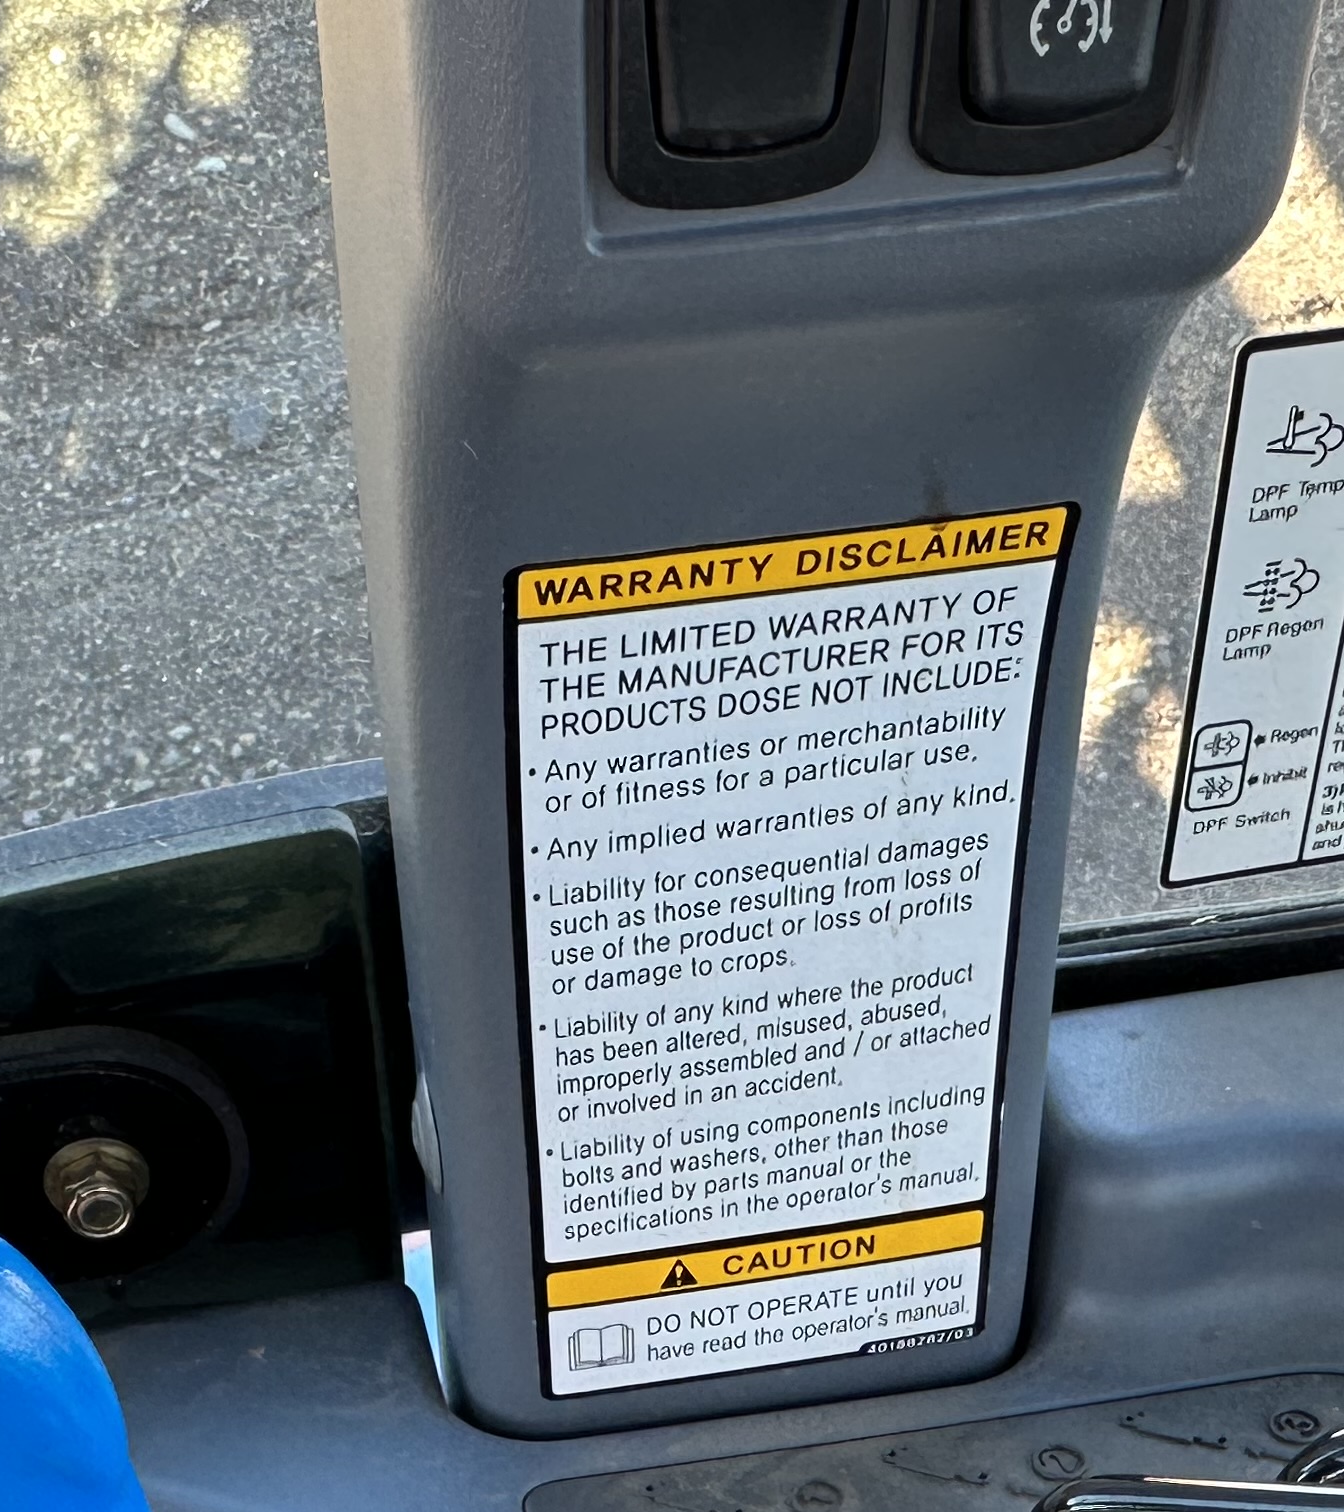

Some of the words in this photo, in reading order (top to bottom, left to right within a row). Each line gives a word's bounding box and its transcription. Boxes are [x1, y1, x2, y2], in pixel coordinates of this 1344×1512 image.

[534, 553, 774, 606] WARRANTY
[796, 521, 1050, 576] DISCLAIMER
[538, 636, 608, 668] THE
[620, 619, 756, 659] LIMITED
[768, 592, 963, 641] WARRANTY
[972, 585, 1019, 616] OF
[539, 672, 606, 704] THE
[618, 638, 890, 695] MANUFACTURER
[901, 628, 966, 661] FOR
[976, 620, 1024, 651] ITS
[541, 695, 706, 740] PRODUCTS
[718, 683, 801, 719] DOSE
[811, 675, 874, 708] NOT
[882, 656, 1024, 698] INCLUDE:
[544, 758, 598, 784] Any
[607, 737, 751, 775] warranties
[759, 735, 789, 756] or
[797, 705, 1007, 751] merchantability
[545, 794, 573, 814] or
[581, 784, 607, 810] of
[616, 777, 706, 806] fitness
[716, 768, 750, 793] for
[759, 769, 774, 788] a
[784, 748, 916, 790] particular
[923, 743, 978, 766] use.
[546, 837, 598, 862] Any
[608, 818, 705, 855] implied
[716, 803, 854, 840] warranties
[863, 794, 888, 821] of
[896, 793, 945, 817] any
[952, 778, 1015, 809] kind.
[549, 875, 646, 907] Liability
[654, 870, 687, 894] for
[694, 842, 870, 889] consequential
[877, 832, 989, 865] damages
[549, 908, 609, 937] such
[617, 908, 646, 929] as
[654, 899, 721, 924] those
[730, 884, 835, 914] resulting
[844, 875, 896, 899] from
[905, 867, 952, 891] loss
[959, 856, 983, 882] of
[551, 945, 594, 967] use
[602, 935, 624, 960] of
[633, 932, 671, 956] the
[679, 917, 774, 956] product
[781, 917, 807, 937] or
[814, 909, 861, 932] loss
[868, 898, 892, 925] of
[898, 891, 973, 925] profits
[551, 976, 577, 996] or
[584, 963, 683, 992] damage
[691, 956, 713, 977] to
[720, 948, 797, 974] crops.
[554, 1010, 639, 1039] Liability
[645, 1003, 666, 1028] of
[673, 1003, 715, 1025] any
[722, 990, 769, 1018] kind
[777, 986, 843, 1010] where
[850, 977, 884, 1000] the
[891, 962, 973, 999] product
[555, 1046, 595, 1068] has
[602, 1039, 658, 1062] been
[666, 1022, 748, 1054] altered,
[756, 1007, 853, 1041] misused,
[860, 993, 947, 1026] abused,
[556, 1061, 673, 1097] improperly
[679, 1041, 798, 1080] assembled
[804, 1035, 846, 1062] and
[852, 1030, 865, 1058] /
[870, 1033, 893, 1052] or
[899, 1013, 992, 1048] attached
[557, 1105, 580, 1123] or
[587, 1086, 676, 1120] involved
[685, 1084, 703, 1106] in
[710, 1084, 737, 1103] an
[745, 1065, 843, 1098] accident.
[560, 1133, 646, 1162] Liability
[652, 1126, 673, 1149] of
[680, 1121, 739, 1146] using
[747, 1100, 881, 1137] components
[888, 1085, 986, 1116] including
[562, 1165, 615, 1188] bolts
[621, 1155, 662, 1181] and
[670, 1146, 767, 1174] washers,
[774, 1135, 831, 1159] other
[837, 1128, 884, 1150] than
[891, 1118, 949, 1142] those
[563, 1181, 663, 1215] identified
[671, 1179, 697, 1202] by
[704, 1171, 759, 1200] parts
[766, 1154, 844, 1186] manual
[850, 1156, 873, 1174] or
[879, 1148, 912, 1169] the
[564, 1205, 713, 1243] specifications
[720, 1198, 739, 1219] in
[746, 1193, 780, 1215] the
[785, 1172, 892, 1212] operator's
[898, 1161, 980, 1192] manual.
[722, 1234, 875, 1276] CAUTION
[646, 1313, 682, 1336] DO
[690, 1303, 740, 1330] NOT
[747, 1286, 859, 1321] OPERATE
[866, 1276, 915, 1303] until
[923, 1273, 963, 1298] you
[647, 1342, 695, 1362] have
[702, 1329, 747, 1354] read
[754, 1326, 784, 1347] the
[791, 1305, 889, 1343] operator's
[895, 1294, 970, 1325] manual.
